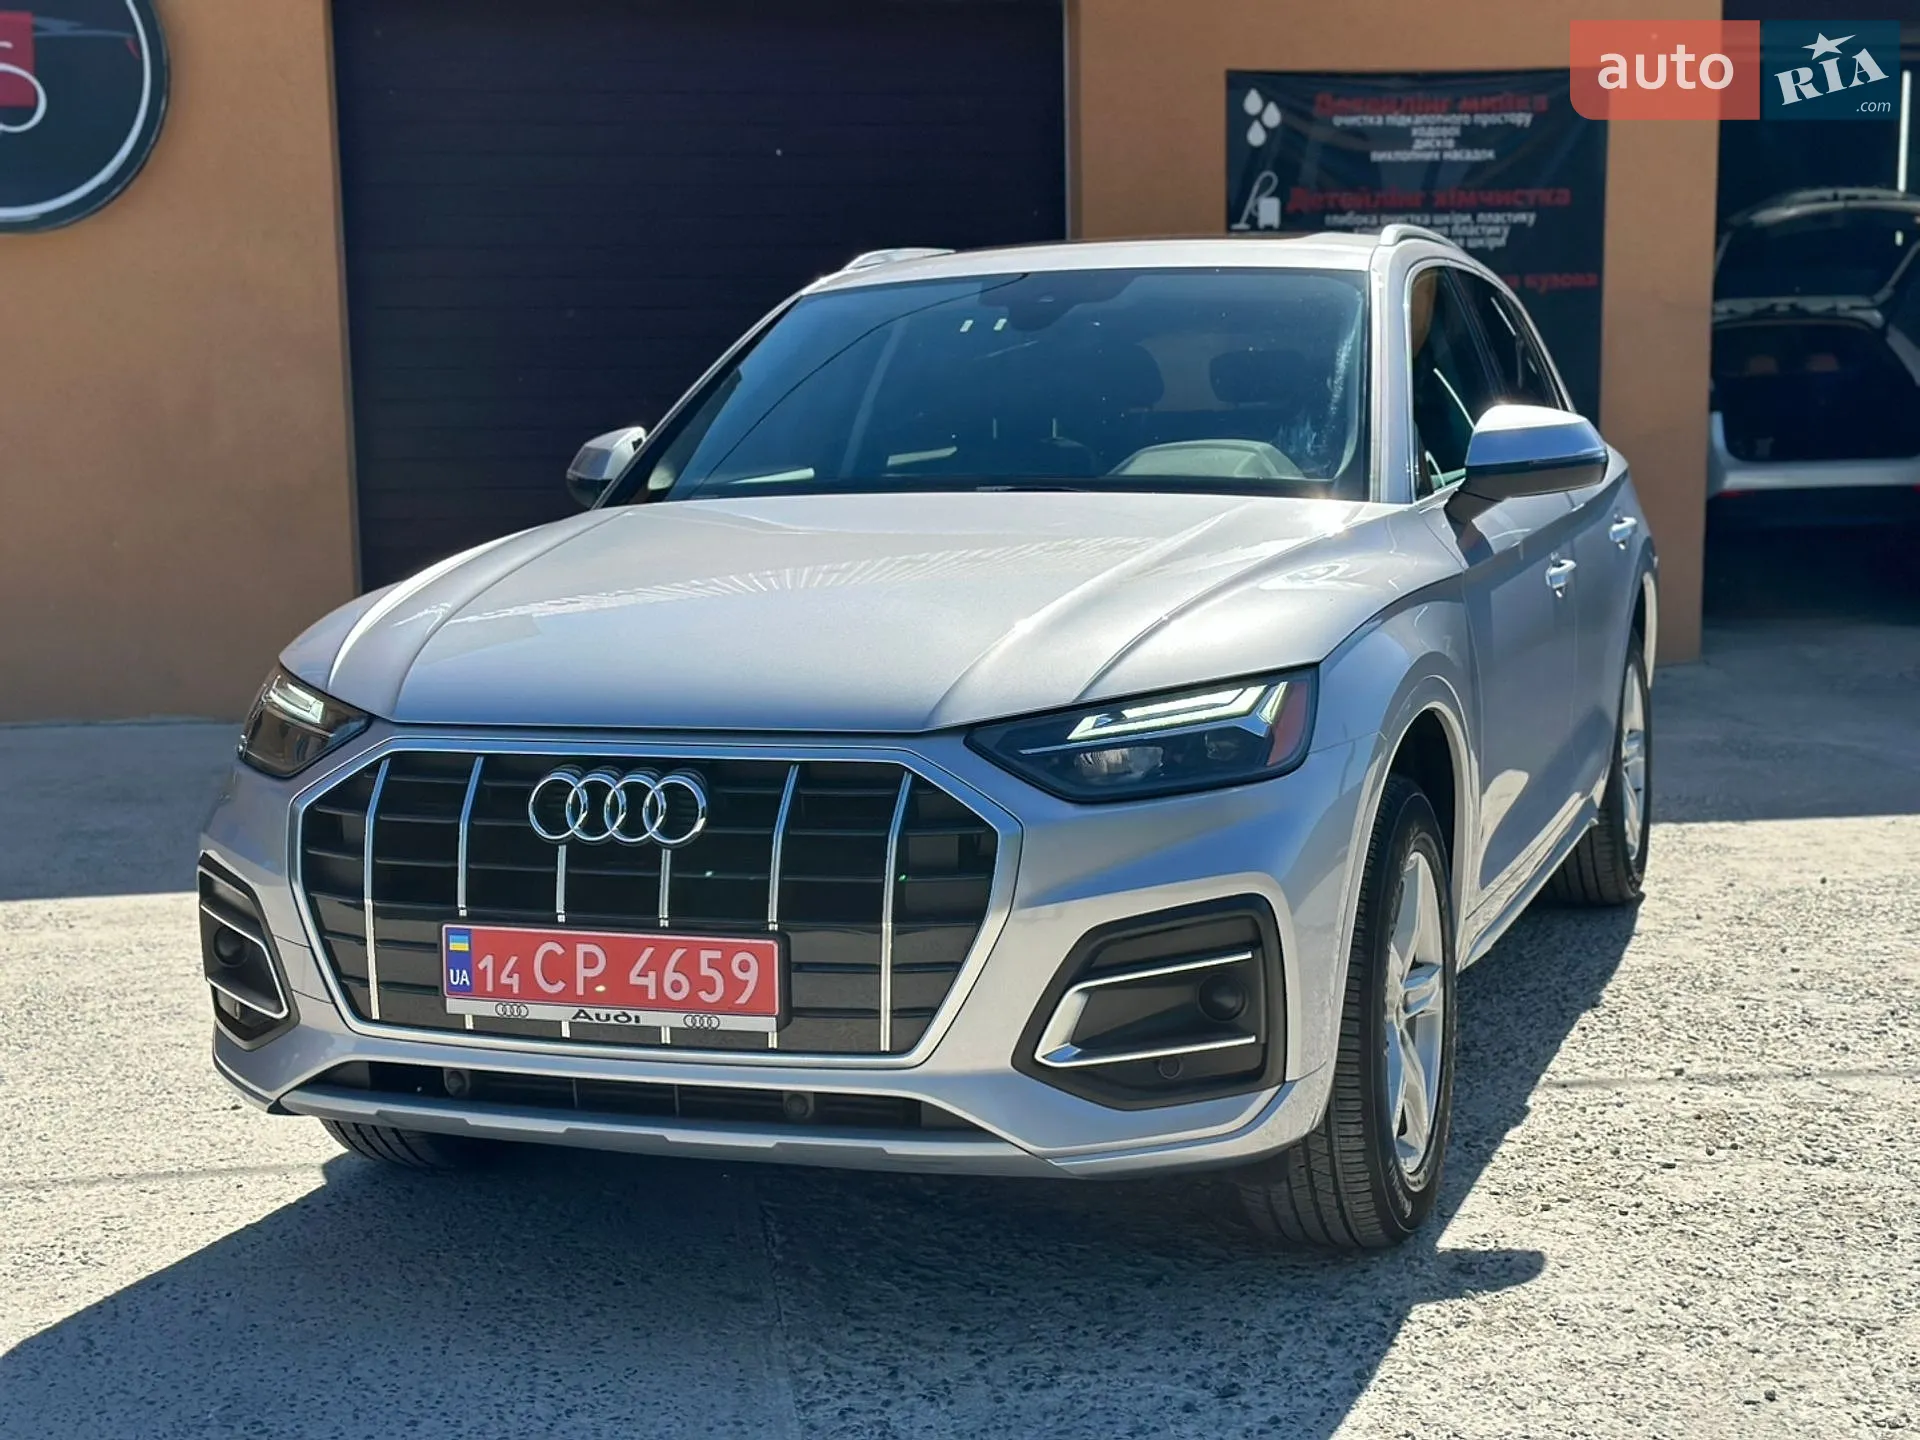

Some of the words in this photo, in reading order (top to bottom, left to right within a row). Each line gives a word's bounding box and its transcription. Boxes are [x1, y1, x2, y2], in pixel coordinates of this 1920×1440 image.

[1473, 112, 1534, 128] простору
[1433, 187, 1571, 208] хімчистка
[449, 968, 471, 987] UA
[477, 954, 520, 995] 14
[533, 941, 608, 996] CP
[628, 946, 760, 1005] 4659
[571, 1008, 641, 1025] Audi
